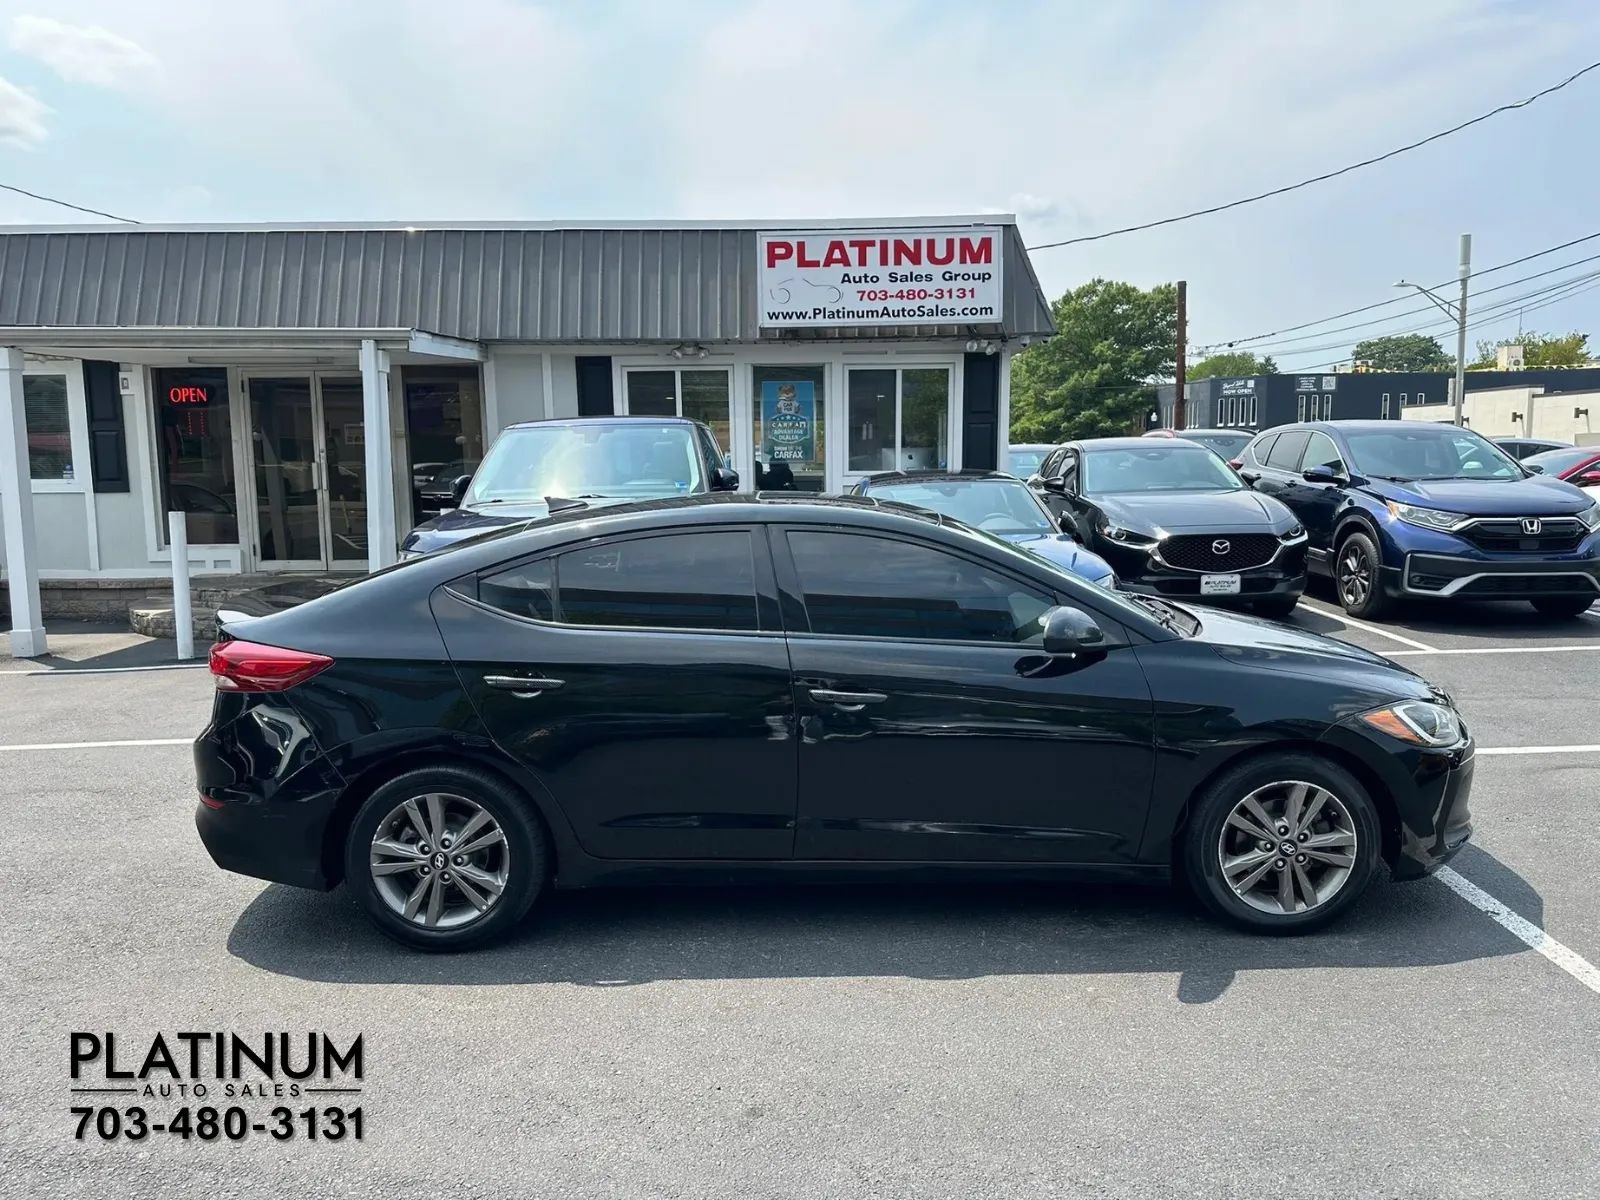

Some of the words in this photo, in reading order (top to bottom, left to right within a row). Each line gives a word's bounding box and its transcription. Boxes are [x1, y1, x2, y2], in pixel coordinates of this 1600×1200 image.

[766, 237, 992, 268] PLATINUM
[840, 272, 880, 284] Auto
[888, 271, 934, 283] Sales
[941, 270, 992, 284] Group
[856, 287, 976, 301] 703-480-3131
[766, 305, 994, 321] www.PlatinumAutoSales.com
[170, 387, 207, 403] OPEN
[774, 450, 803, 459] CARFAX
